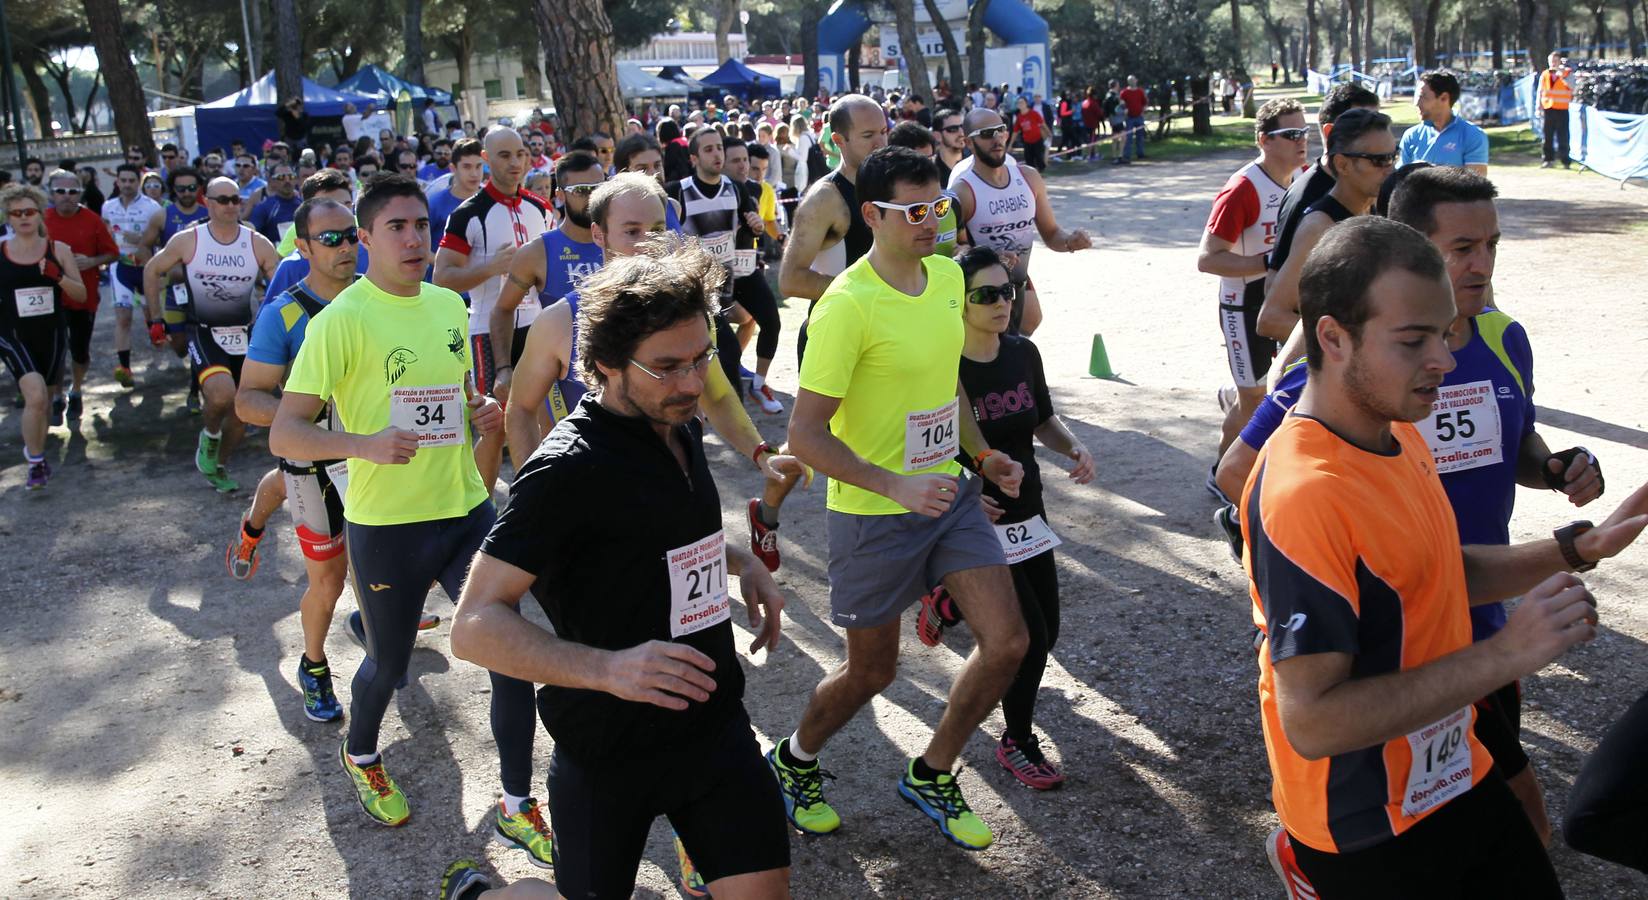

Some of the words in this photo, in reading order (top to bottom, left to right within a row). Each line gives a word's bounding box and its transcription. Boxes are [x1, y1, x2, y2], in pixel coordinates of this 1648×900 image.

[989, 194, 1029, 216] CARABIAS
[206, 253, 246, 268] RUANO
[28, 295, 44, 306] 23
[221, 334, 242, 346] 275
[1440, 402, 1448, 410] DE
[1449, 396, 1484, 408] VALLADOLID
[415, 403, 446, 426] 34
[921, 419, 954, 448] 104
[1435, 409, 1476, 442] 55
[419, 432, 457, 441] alia.com
[1434, 447, 1493, 464] rsalia.com
[1005, 524, 1033, 545] 62
[686, 558, 723, 602] 277
[1424, 726, 1462, 773] 149
